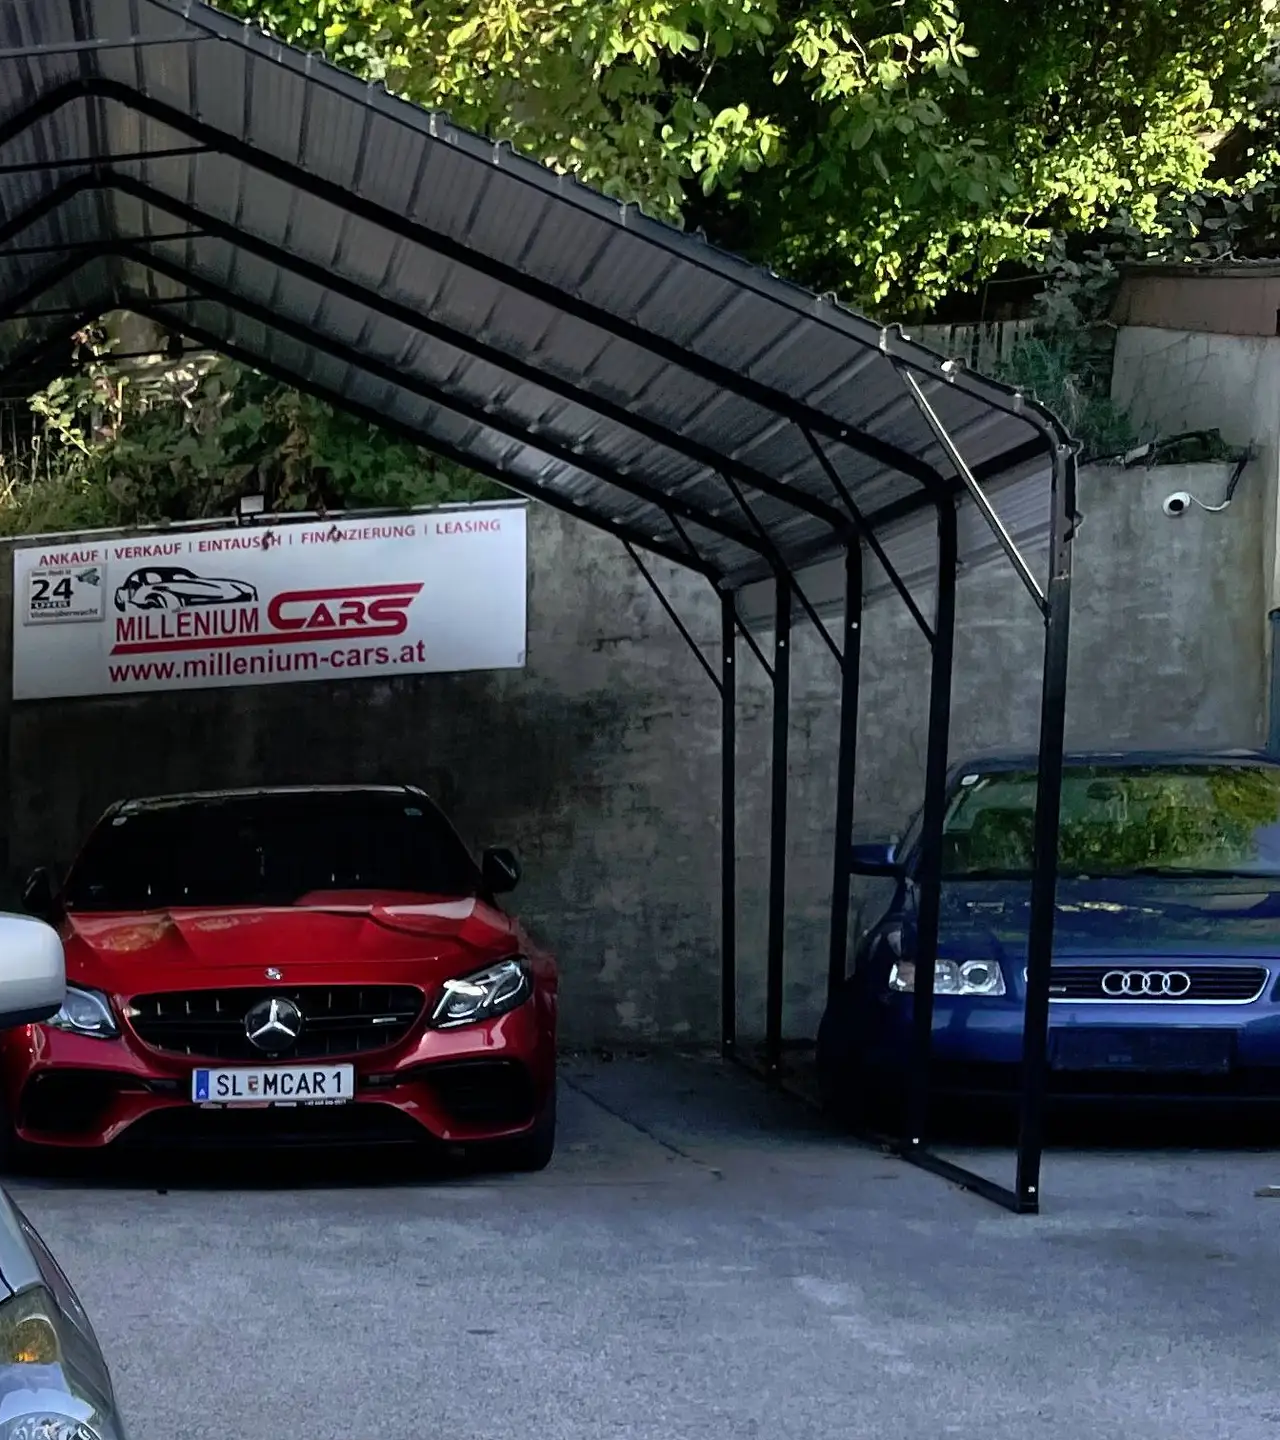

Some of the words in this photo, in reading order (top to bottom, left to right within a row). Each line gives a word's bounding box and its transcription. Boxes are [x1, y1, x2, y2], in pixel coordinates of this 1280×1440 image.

[39, 550, 99, 567] ANKAUF
[114, 542, 183, 560] VERKAUF
[435, 518, 502, 535] LEASING
[31, 578, 74, 600] 24
[116, 608, 259, 643] MILLENIUM
[267, 582, 425, 637] CARS
[109, 639, 426, 683] www.millenium-cars.at
[217, 1074, 243, 1096] SL
